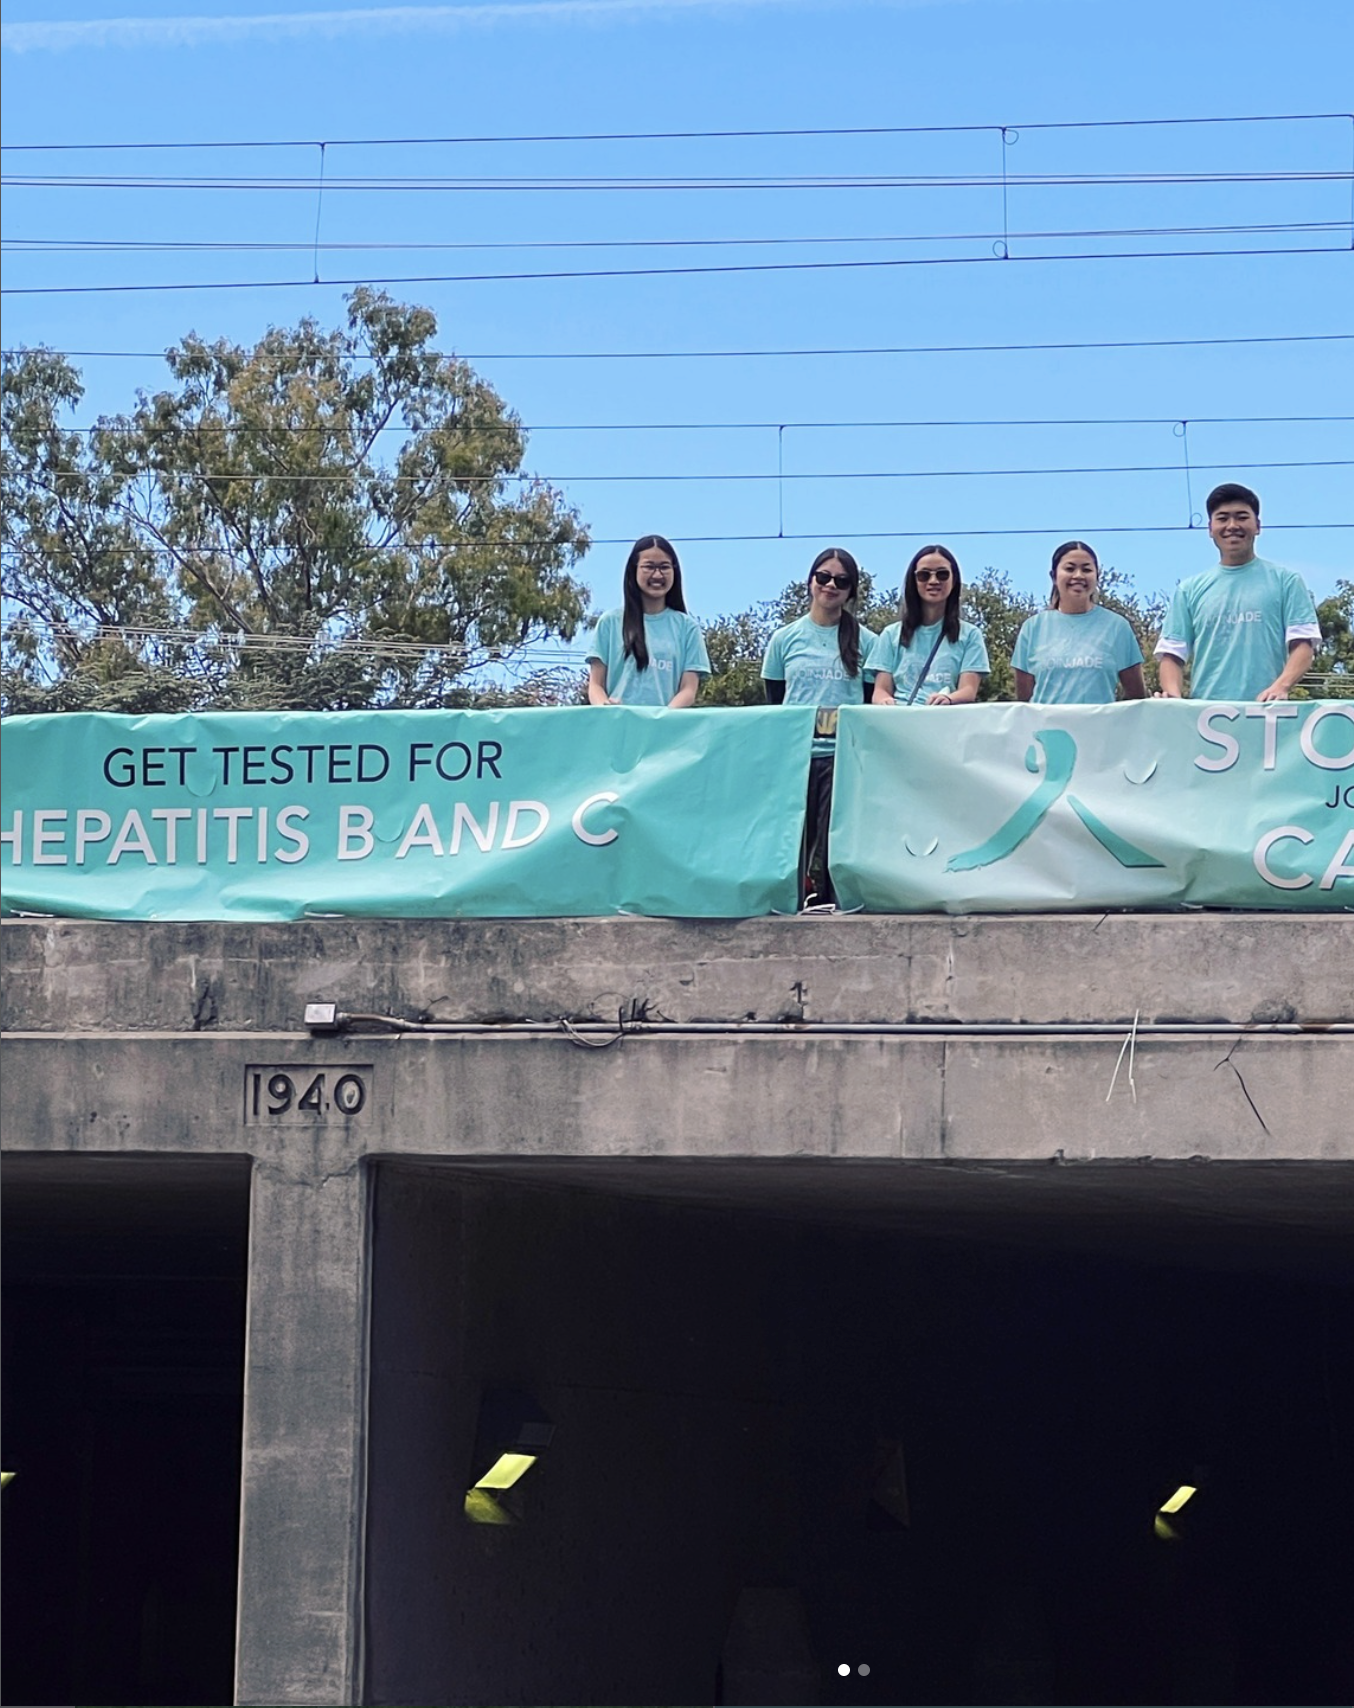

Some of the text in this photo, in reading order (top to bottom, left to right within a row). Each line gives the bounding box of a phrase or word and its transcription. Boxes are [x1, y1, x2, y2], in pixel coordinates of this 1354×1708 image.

[103, 741, 503, 787] GET TESTED FOR
[338, 805, 375, 861] B
[394, 800, 550, 859] AND
[572, 791, 621, 846] C
[252, 1073, 367, 1116] 1940
